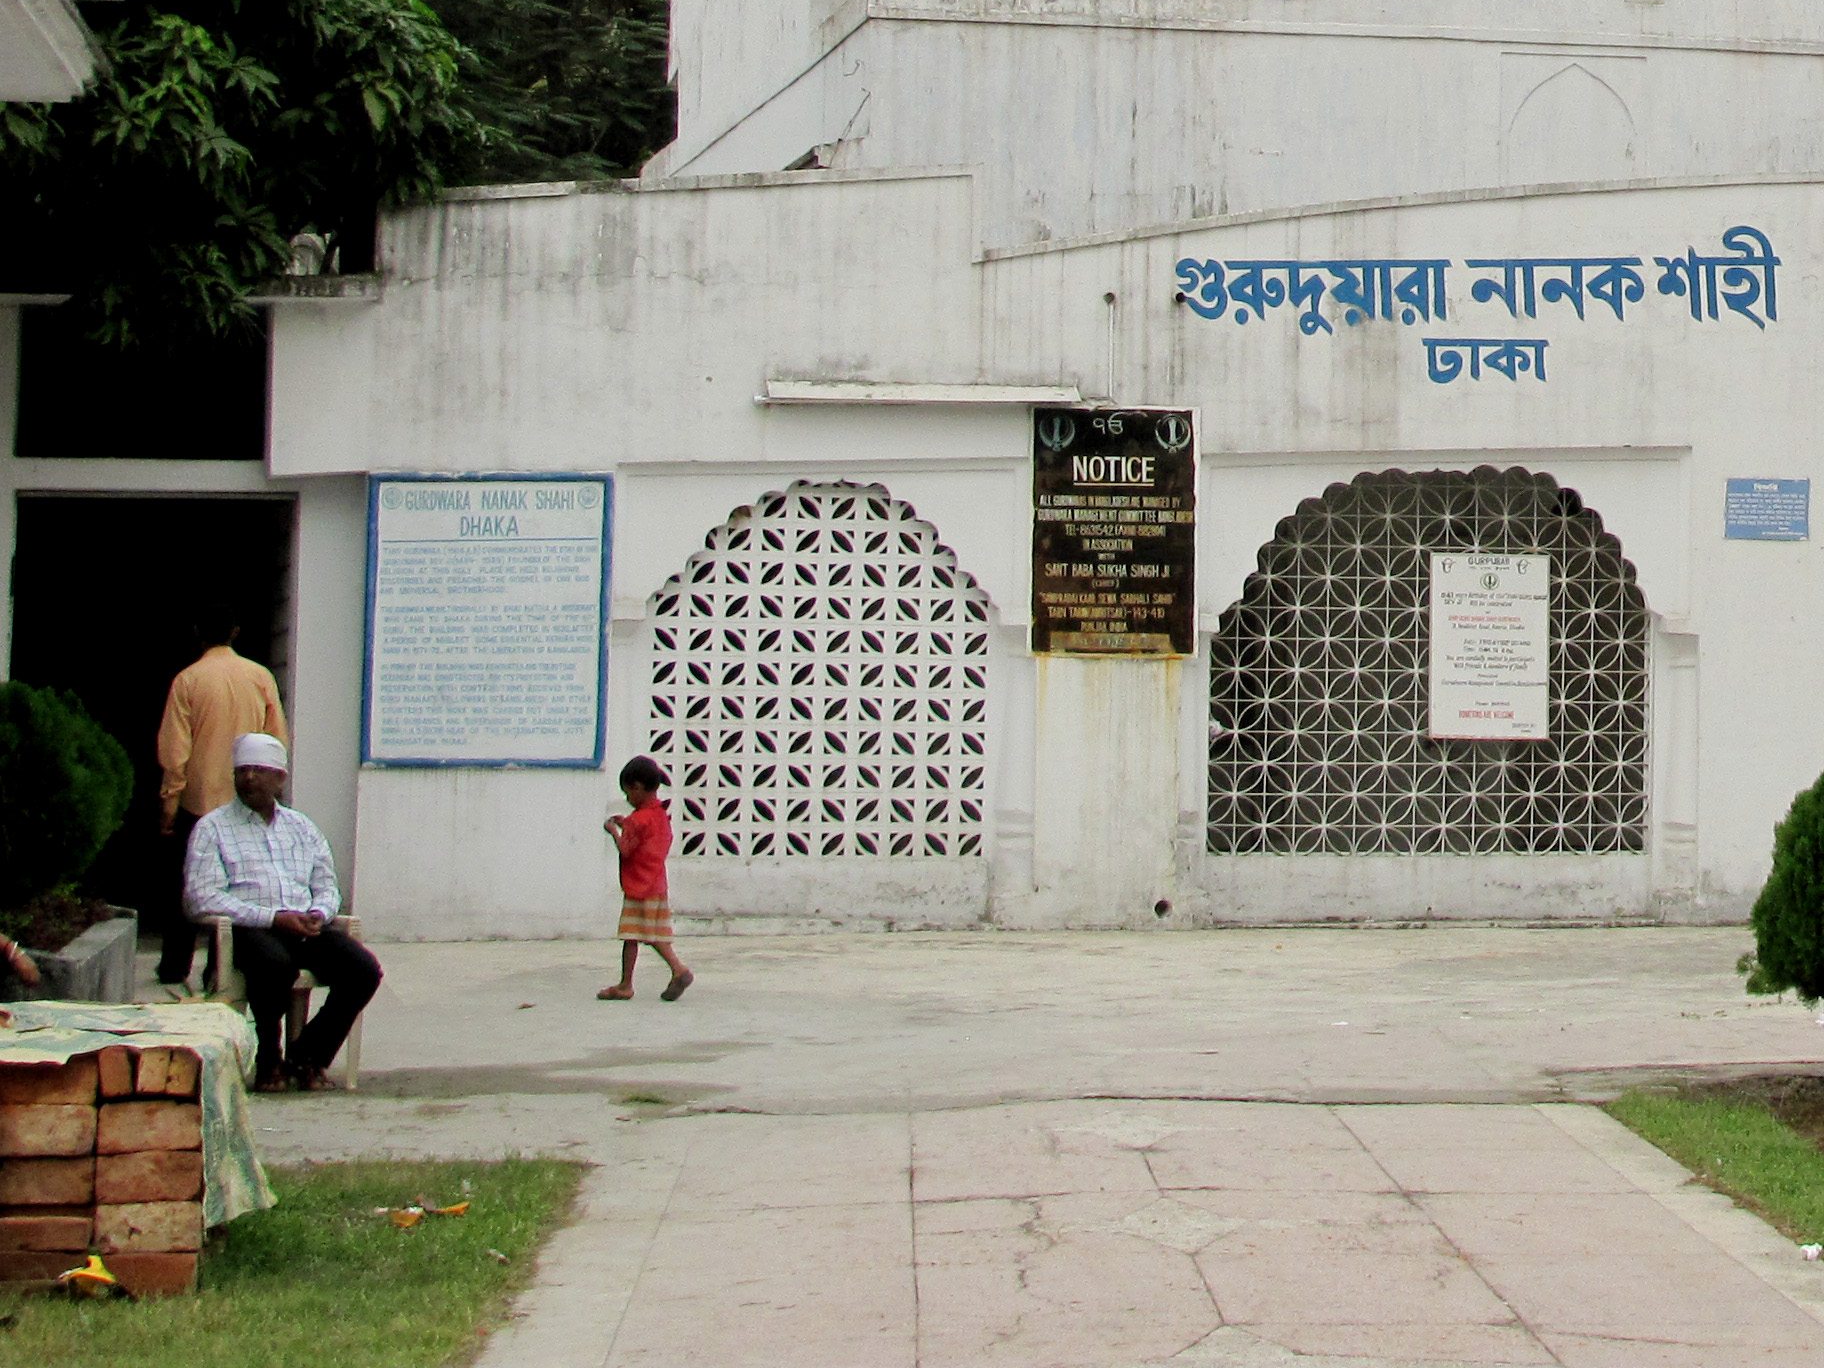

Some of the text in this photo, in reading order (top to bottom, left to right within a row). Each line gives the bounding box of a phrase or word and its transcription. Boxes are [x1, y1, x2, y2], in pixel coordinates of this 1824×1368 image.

[1175, 225, 1780, 335] গুরুদুয়ারা নানক শাহী
[1423, 338, 1548, 384] ঢাকা
[1073, 455, 1155, 482] NOTICE
[405, 490, 575, 511] GURDWARA NANAK SHAHI
[459, 515, 519, 538] DHAKA
[1071, 563, 1094, 578] BABA
[1096, 563, 1128, 579] SUKHA
[1130, 564, 1160, 579] SINGH
